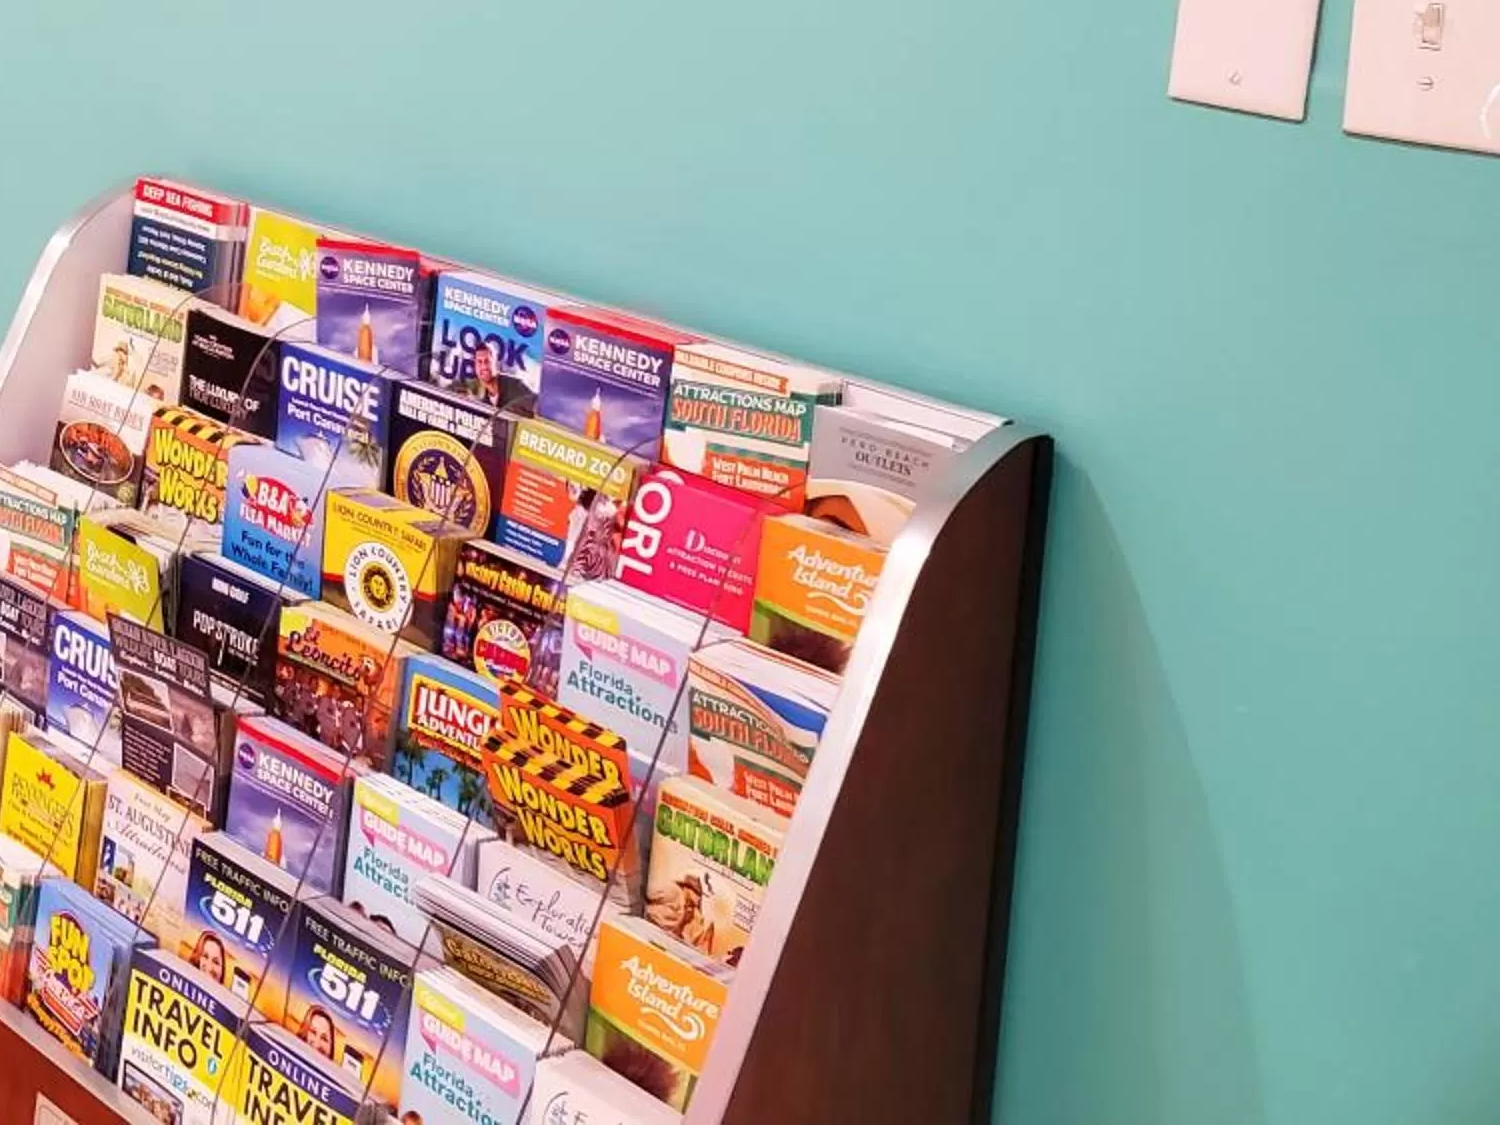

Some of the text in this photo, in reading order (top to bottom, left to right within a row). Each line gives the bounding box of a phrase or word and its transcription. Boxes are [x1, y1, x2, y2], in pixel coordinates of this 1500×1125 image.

[343, 258, 414, 282] KENNEDY
[343, 274, 414, 294] SPACE CENTER
[443, 299, 472, 317] SPACE
[472, 307, 510, 327] CENTER
[444, 286, 510, 317] KENNEDY
[441, 318, 530, 371] LOOK
[573, 334, 664, 374] KENNEDY
[281, 355, 379, 422] CRUISE
[573, 351, 662, 388] SPACE CENTER
[671, 397, 802, 443] SOUTH FLORIDA
[673, 384, 807, 416] ATTRACTIONS MAP
[518, 429, 628, 484] BREVARD ZOO
[854, 450, 913, 476] OUTLETS
[158, 467, 220, 525] WORKS
[241, 530, 262, 548] Fun
[265, 539, 282, 557] for
[615, 481, 673, 579] ORL
[231, 541, 268, 571] Whole
[787, 544, 881, 587] Adventur
[793, 566, 852, 600] Island
[53, 624, 120, 691] CRUIS
[577, 624, 672, 676] GUIDE MAP
[578, 659, 633, 695] Florida
[566, 670, 679, 734] Attractions
[508, 706, 624, 783] WONDER
[256, 767, 291, 794] SPACE
[257, 753, 334, 801] KENNEDY
[494, 762, 611, 849] WONDER
[363, 846, 410, 885] Florida
[408, 838, 446, 869] MAP
[516, 806, 609, 881] WORKS
[195, 849, 290, 914] FREE TRAFFIC INFO
[203, 872, 254, 908] FLORIDA
[50, 914, 91, 964] FUN
[210, 891, 266, 944] 511
[304, 915, 411, 988] FREE TRAFFIC INFO
[312, 942, 368, 983] FLORIDA
[158, 967, 219, 1018] ONLINE
[318, 963, 381, 1022] 511
[621, 955, 721, 1020] Adventure
[628, 977, 682, 1024] Island
[132, 1006, 199, 1071] INFO
[133, 975, 224, 1060] TRAVEL
[267, 1049, 332, 1103] ONLINE
[422, 1052, 474, 1098] Florida
[473, 1048, 516, 1082] MAP
[409, 1062, 502, 1125] Attractio
